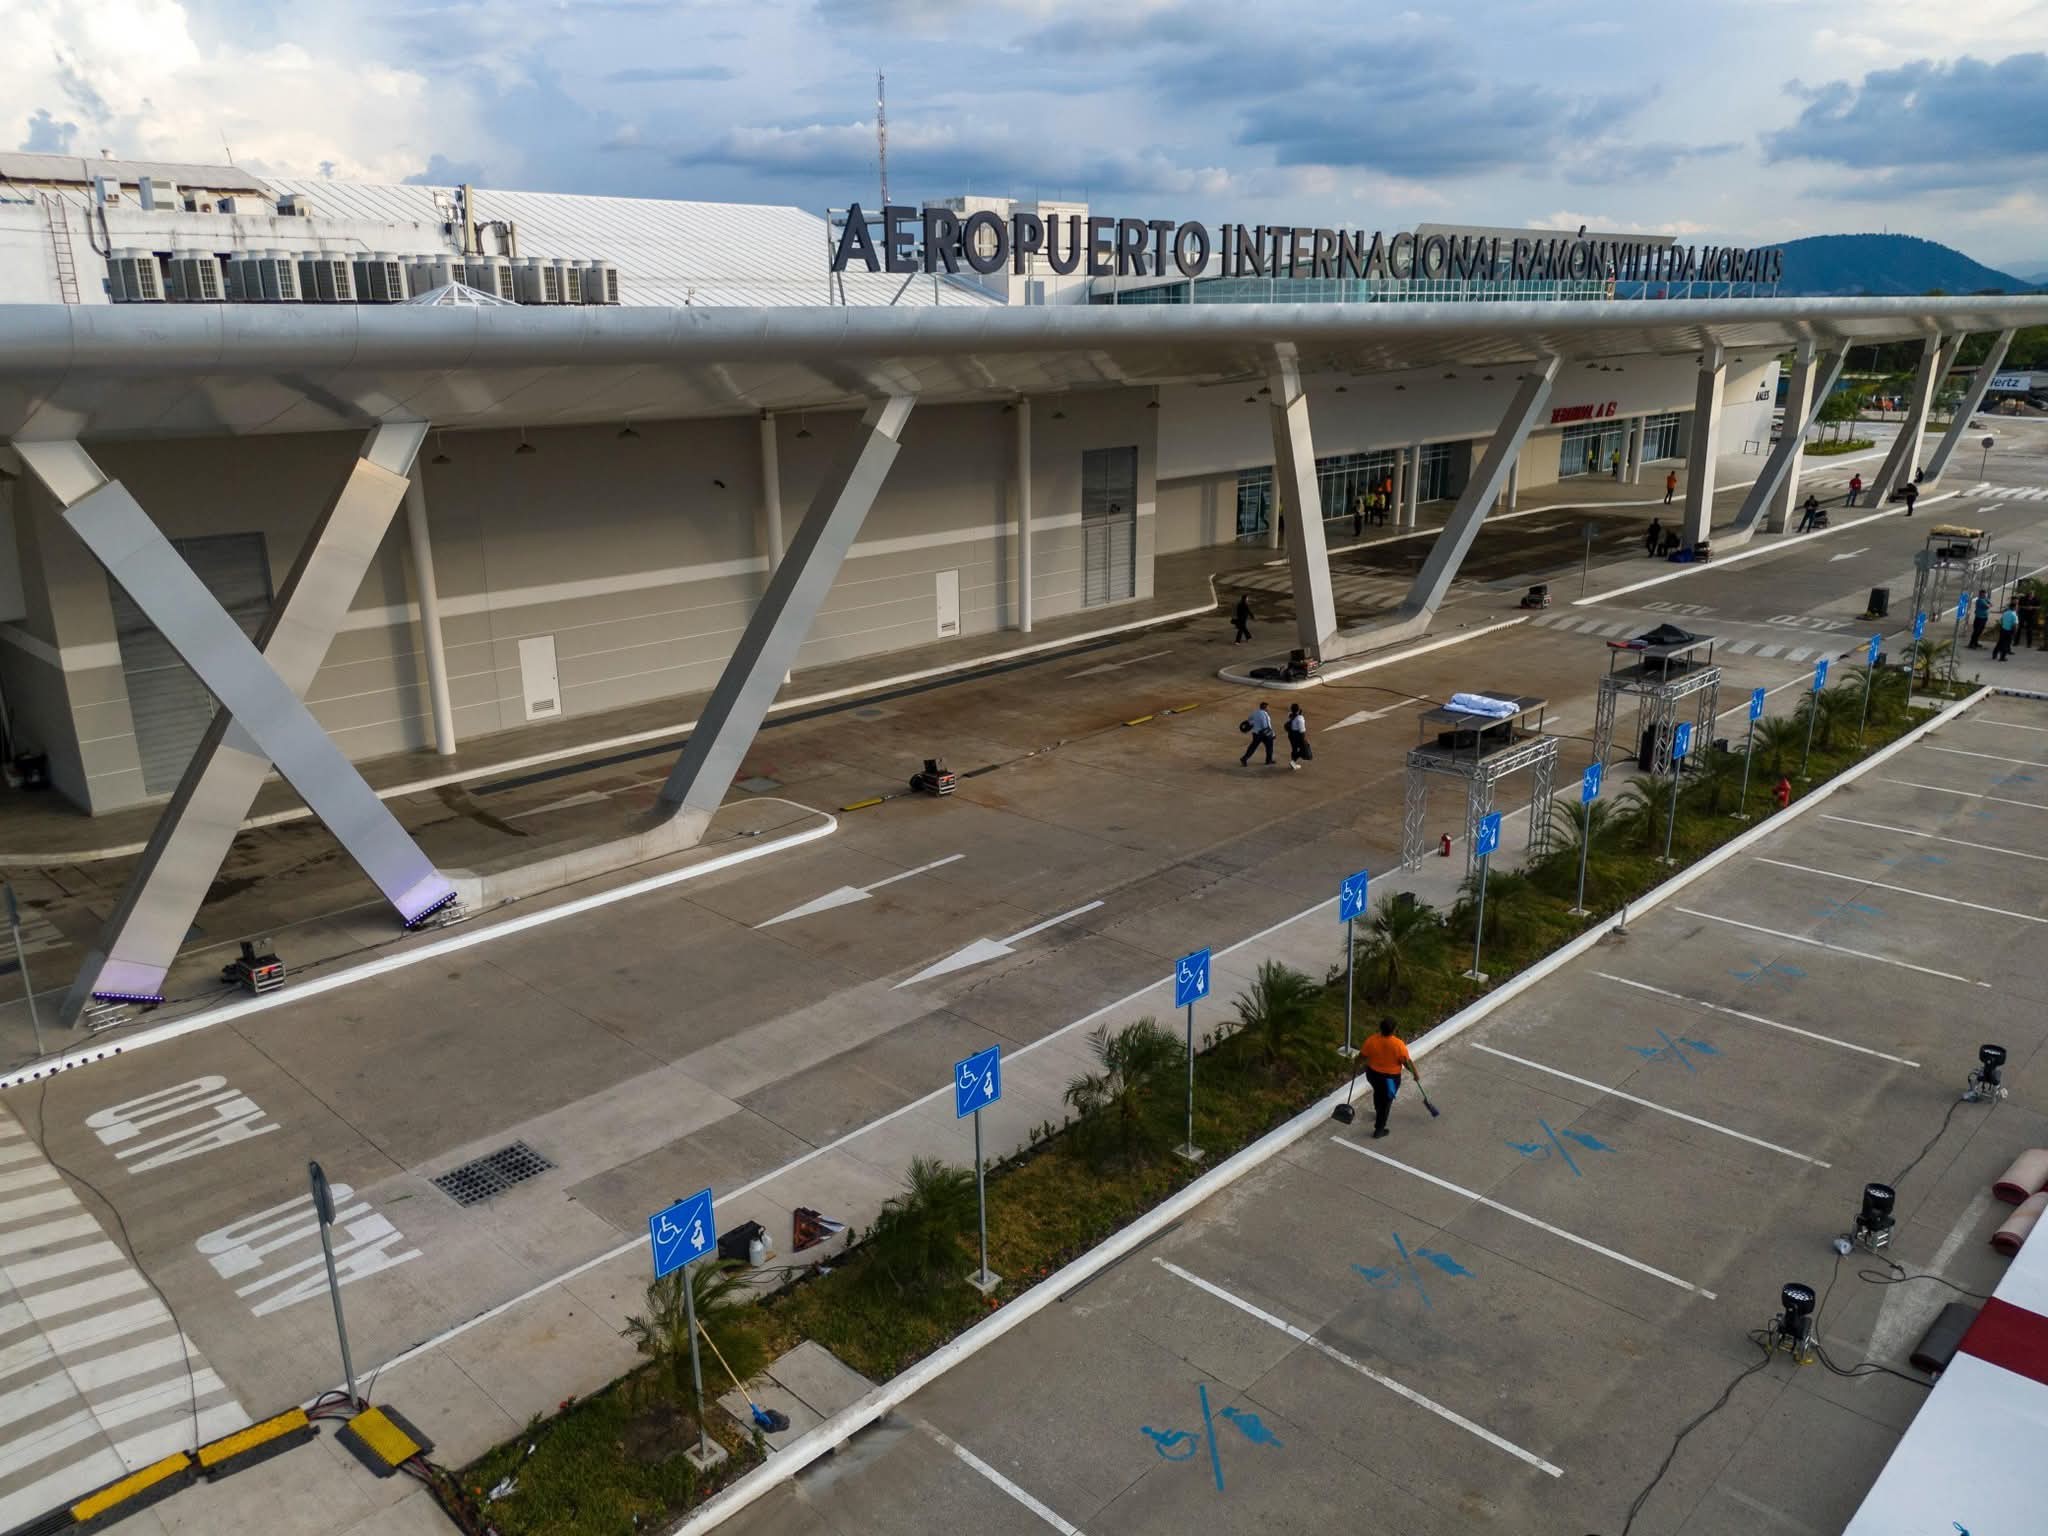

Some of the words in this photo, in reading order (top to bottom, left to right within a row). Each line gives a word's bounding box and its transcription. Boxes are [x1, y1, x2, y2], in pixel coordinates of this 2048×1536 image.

[832, 202, 1210, 278] AEROPUERTO
[1221, 224, 1504, 279] INTERNACIONAL
[1511, 225, 1608, 281] RAMÓN
[1766, 614, 1852, 631] ALTO
[85, 1075, 281, 1174] ALTO
[196, 1183, 424, 1318] ALTO
